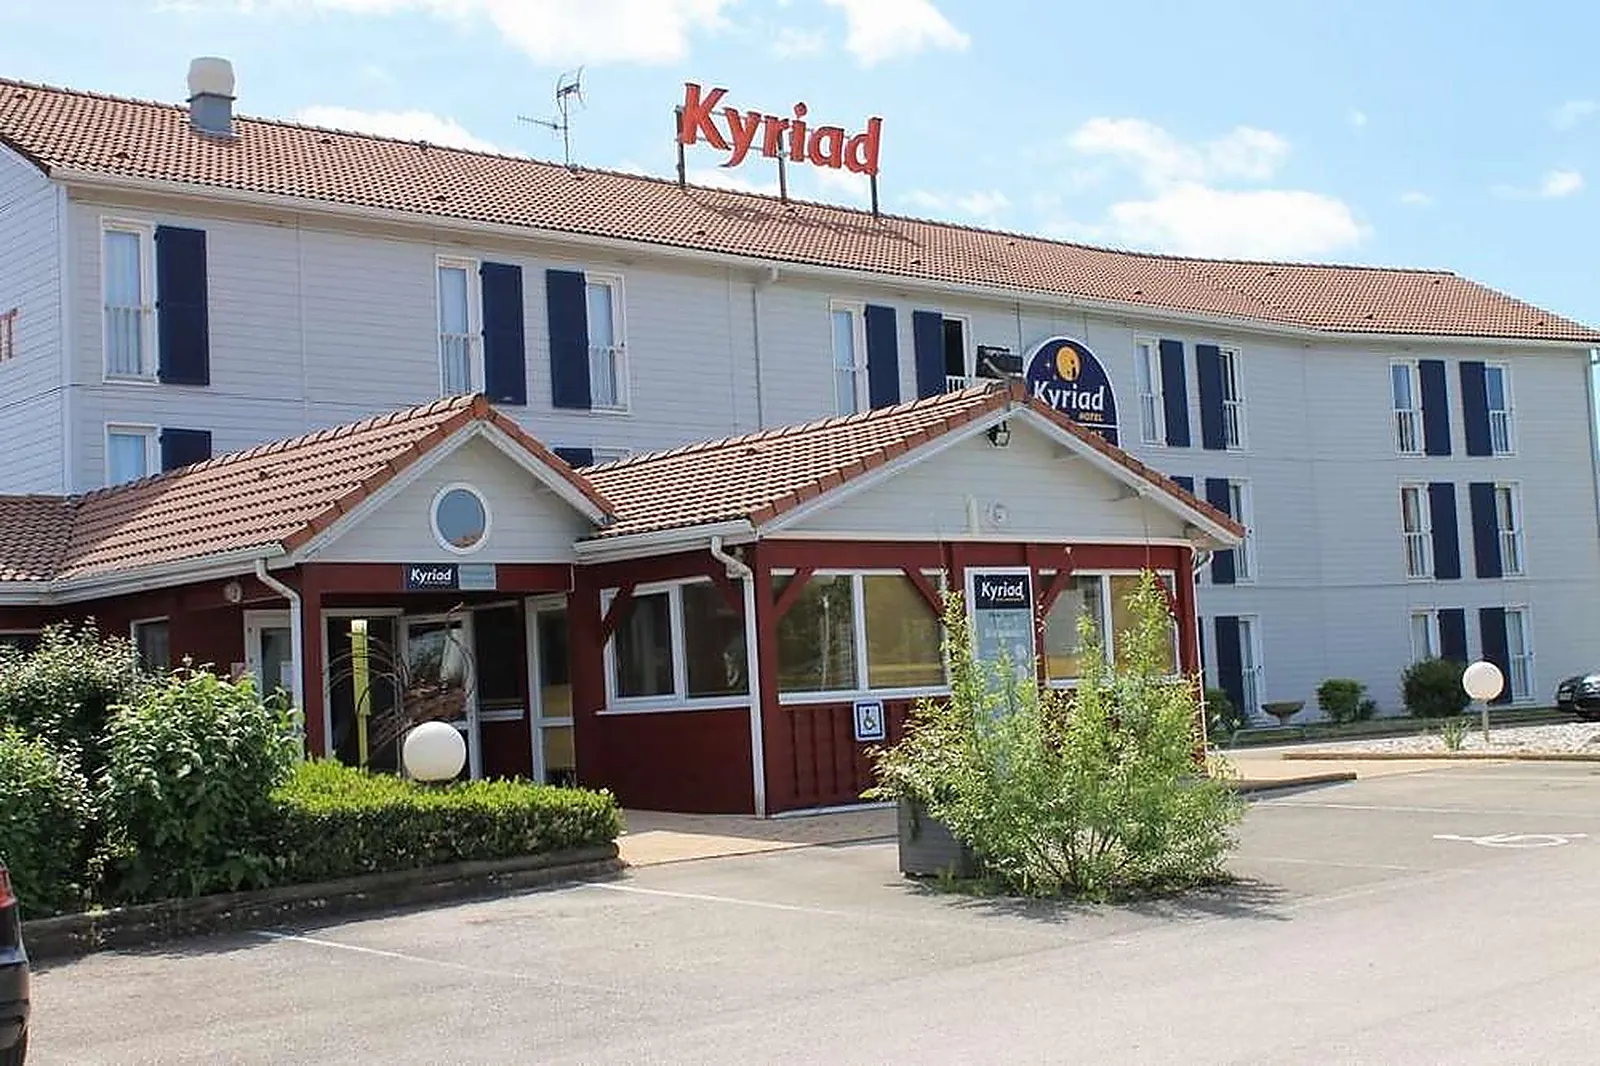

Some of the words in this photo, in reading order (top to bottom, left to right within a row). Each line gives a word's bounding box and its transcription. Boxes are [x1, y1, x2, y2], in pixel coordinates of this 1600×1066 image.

[681, 82, 883, 176] Kyriad
[1033, 380, 1105, 410] Kyriad
[410, 567, 452, 585] Kyriad
[981, 581, 1024, 601] Kyriad
